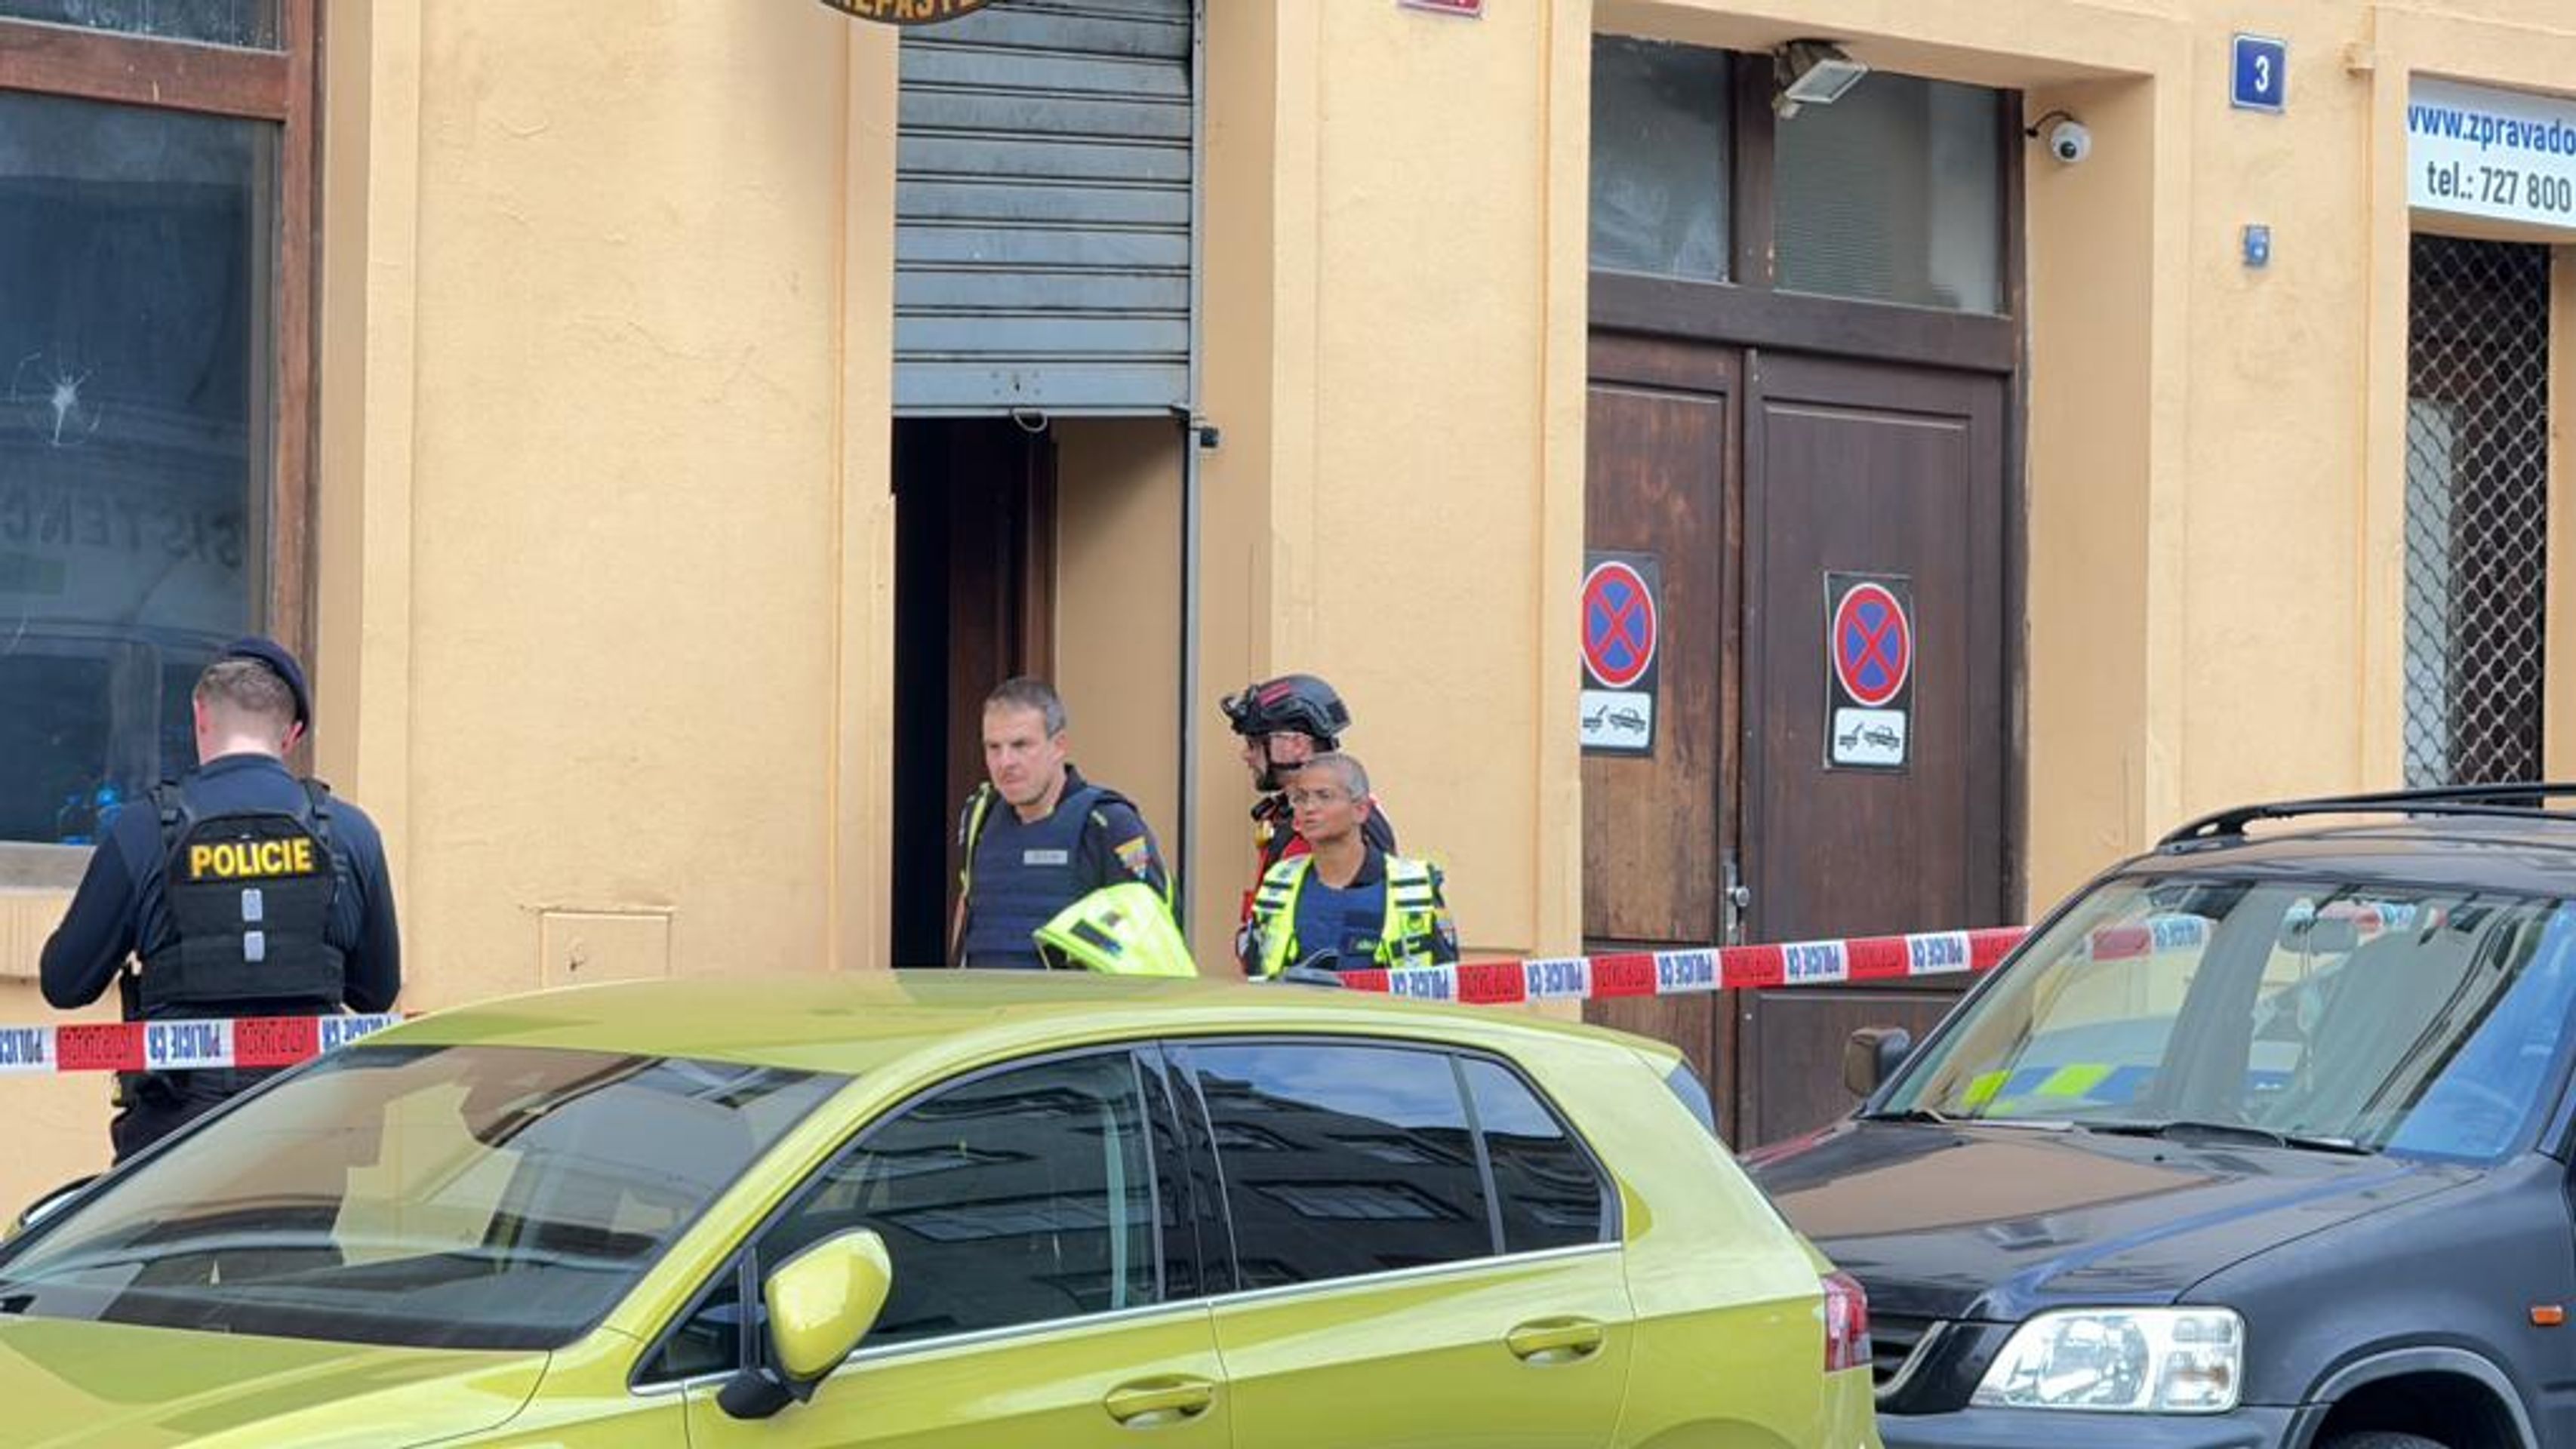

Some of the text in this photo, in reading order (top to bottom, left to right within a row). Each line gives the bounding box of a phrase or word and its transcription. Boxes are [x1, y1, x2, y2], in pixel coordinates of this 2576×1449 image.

[2254, 56, 2270, 93] 3
[2427, 161, 2571, 213] tel.: 727 800
[191, 837, 313, 878] POLICIE
[171, 1023, 220, 1059] POLICIE
